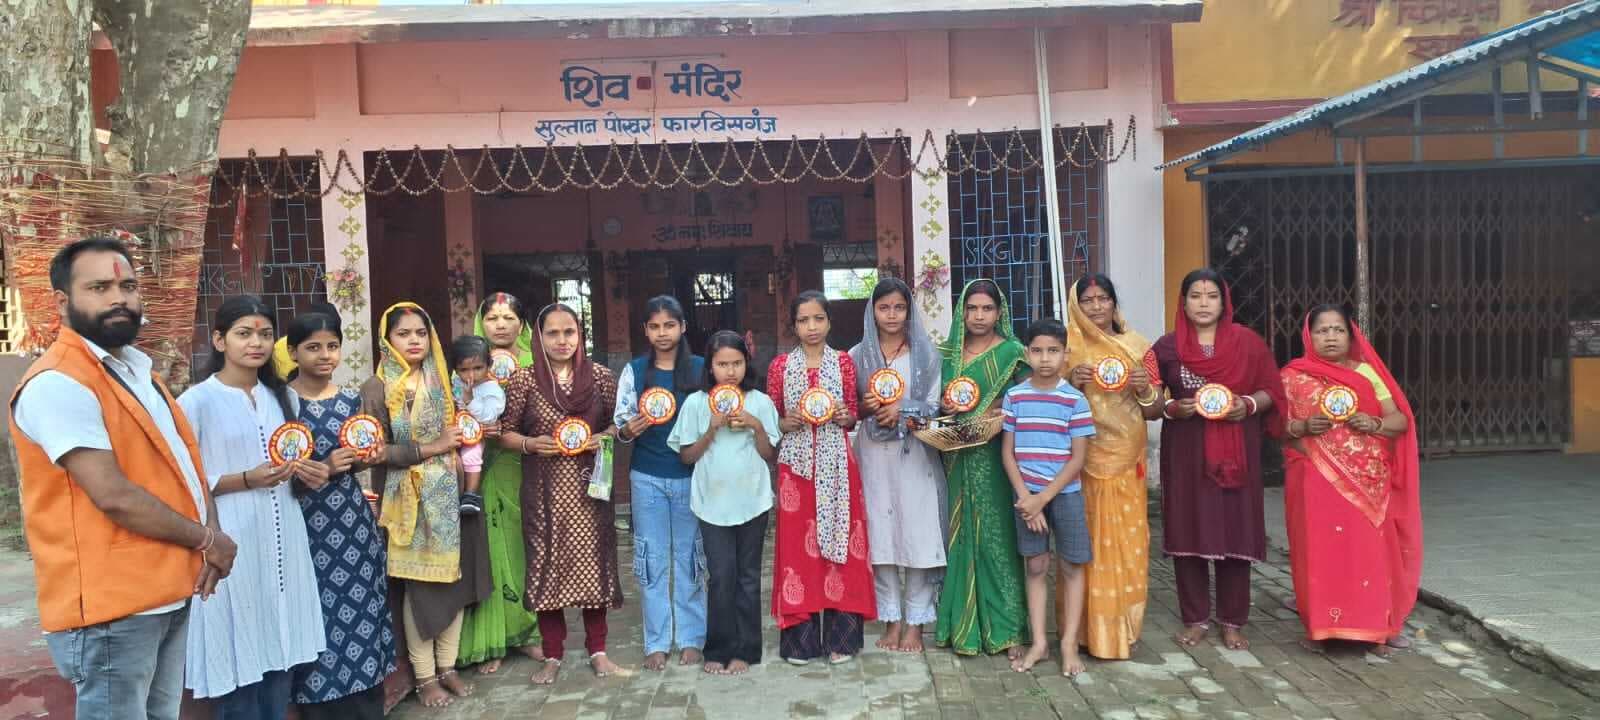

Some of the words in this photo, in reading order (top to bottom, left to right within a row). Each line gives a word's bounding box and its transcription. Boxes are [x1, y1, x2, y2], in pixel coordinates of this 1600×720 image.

[560, 66, 631, 107] शिव
[664, 63, 742, 102] मंदिर
[534, 118, 598, 143] सुल्तान
